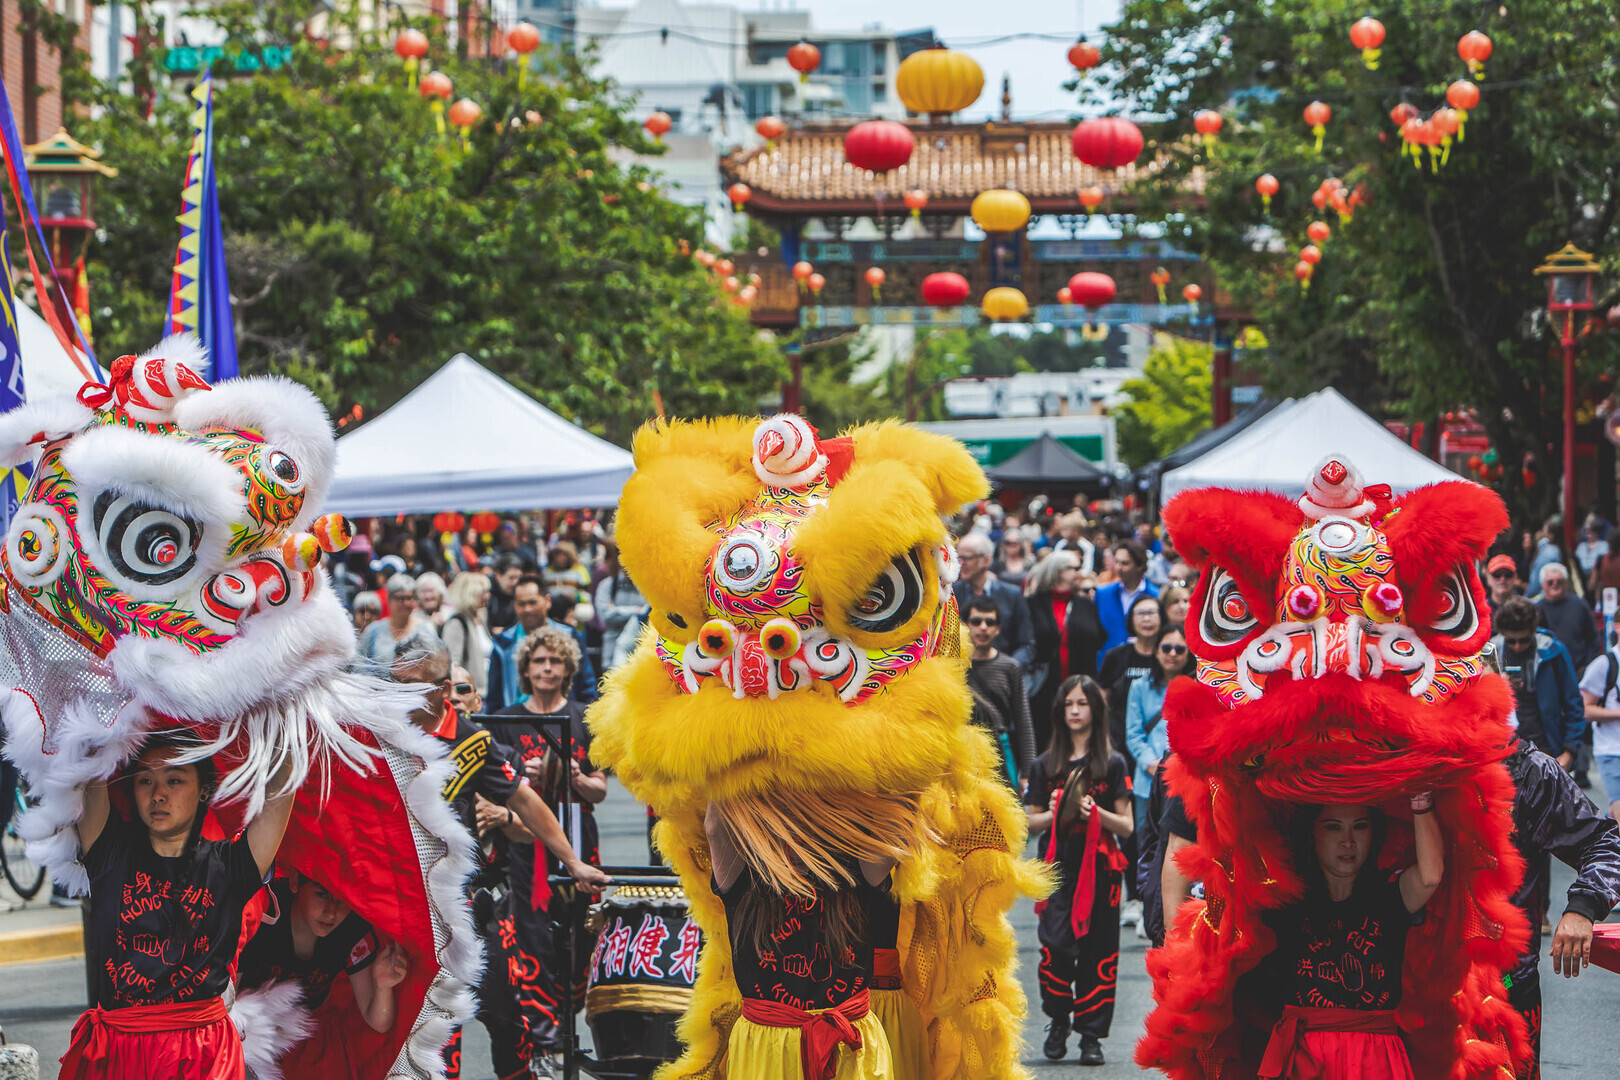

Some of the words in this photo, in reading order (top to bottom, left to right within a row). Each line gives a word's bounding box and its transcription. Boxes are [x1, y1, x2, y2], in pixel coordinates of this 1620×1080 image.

[120, 894, 162, 925] HUNG
[769, 917, 801, 944] HUN
[1346, 931, 1377, 956] FUT
[118, 960, 156, 993] KUNG
[1297, 958, 1314, 978] 洪
[178, 984, 194, 1001] FU
[826, 978, 848, 1004] FU
